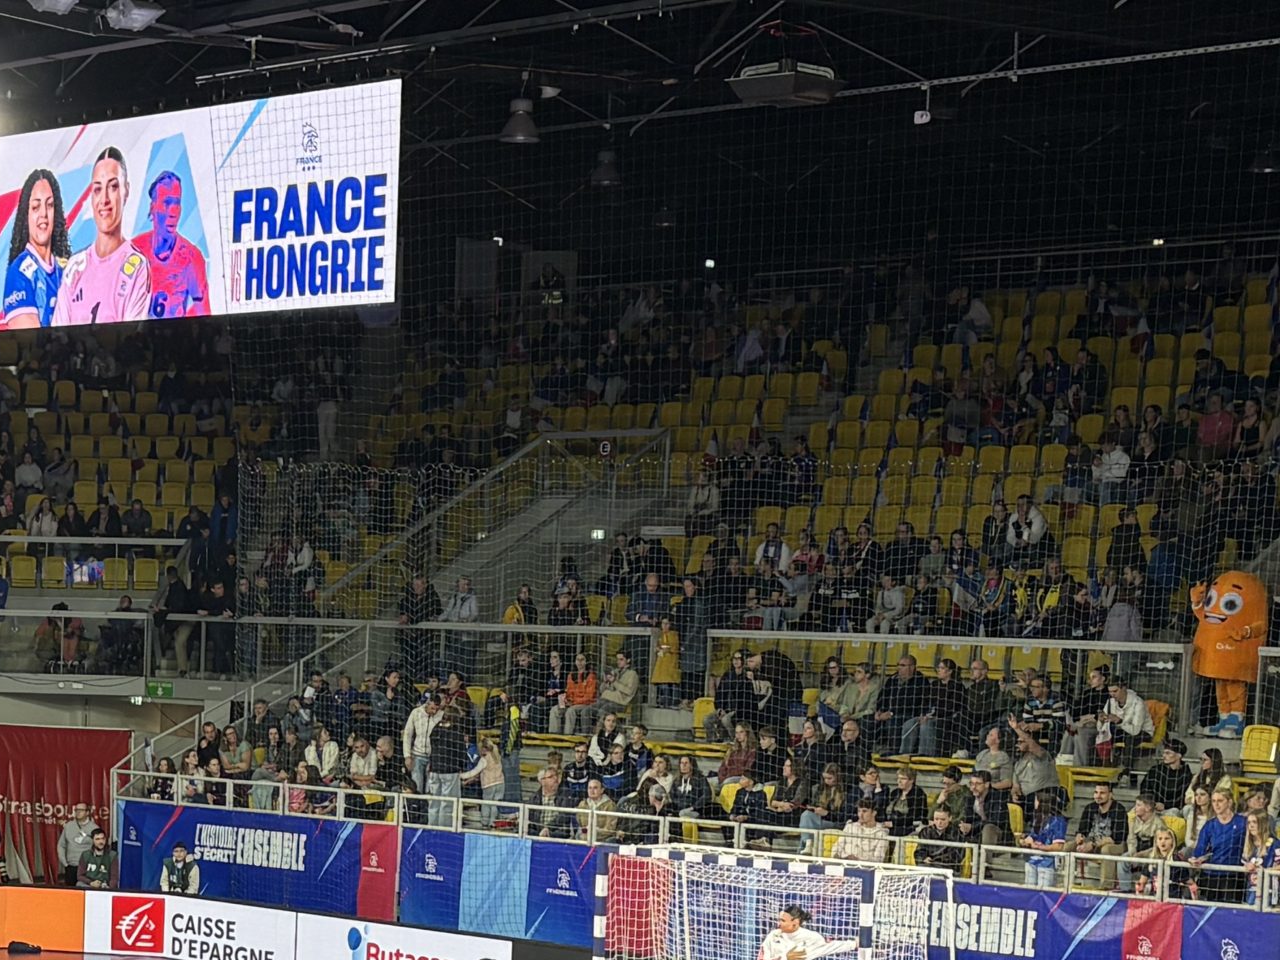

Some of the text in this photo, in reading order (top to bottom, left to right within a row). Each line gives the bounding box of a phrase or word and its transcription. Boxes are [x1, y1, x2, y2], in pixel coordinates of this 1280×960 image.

[232, 173, 387, 243] FRANCE
[245, 236, 385, 301] HONGRIE
[236, 827, 307, 871] ENSEMBLE
[171, 913, 236, 941] CAISSE
[930, 901, 1037, 958] ENSEMBLE
